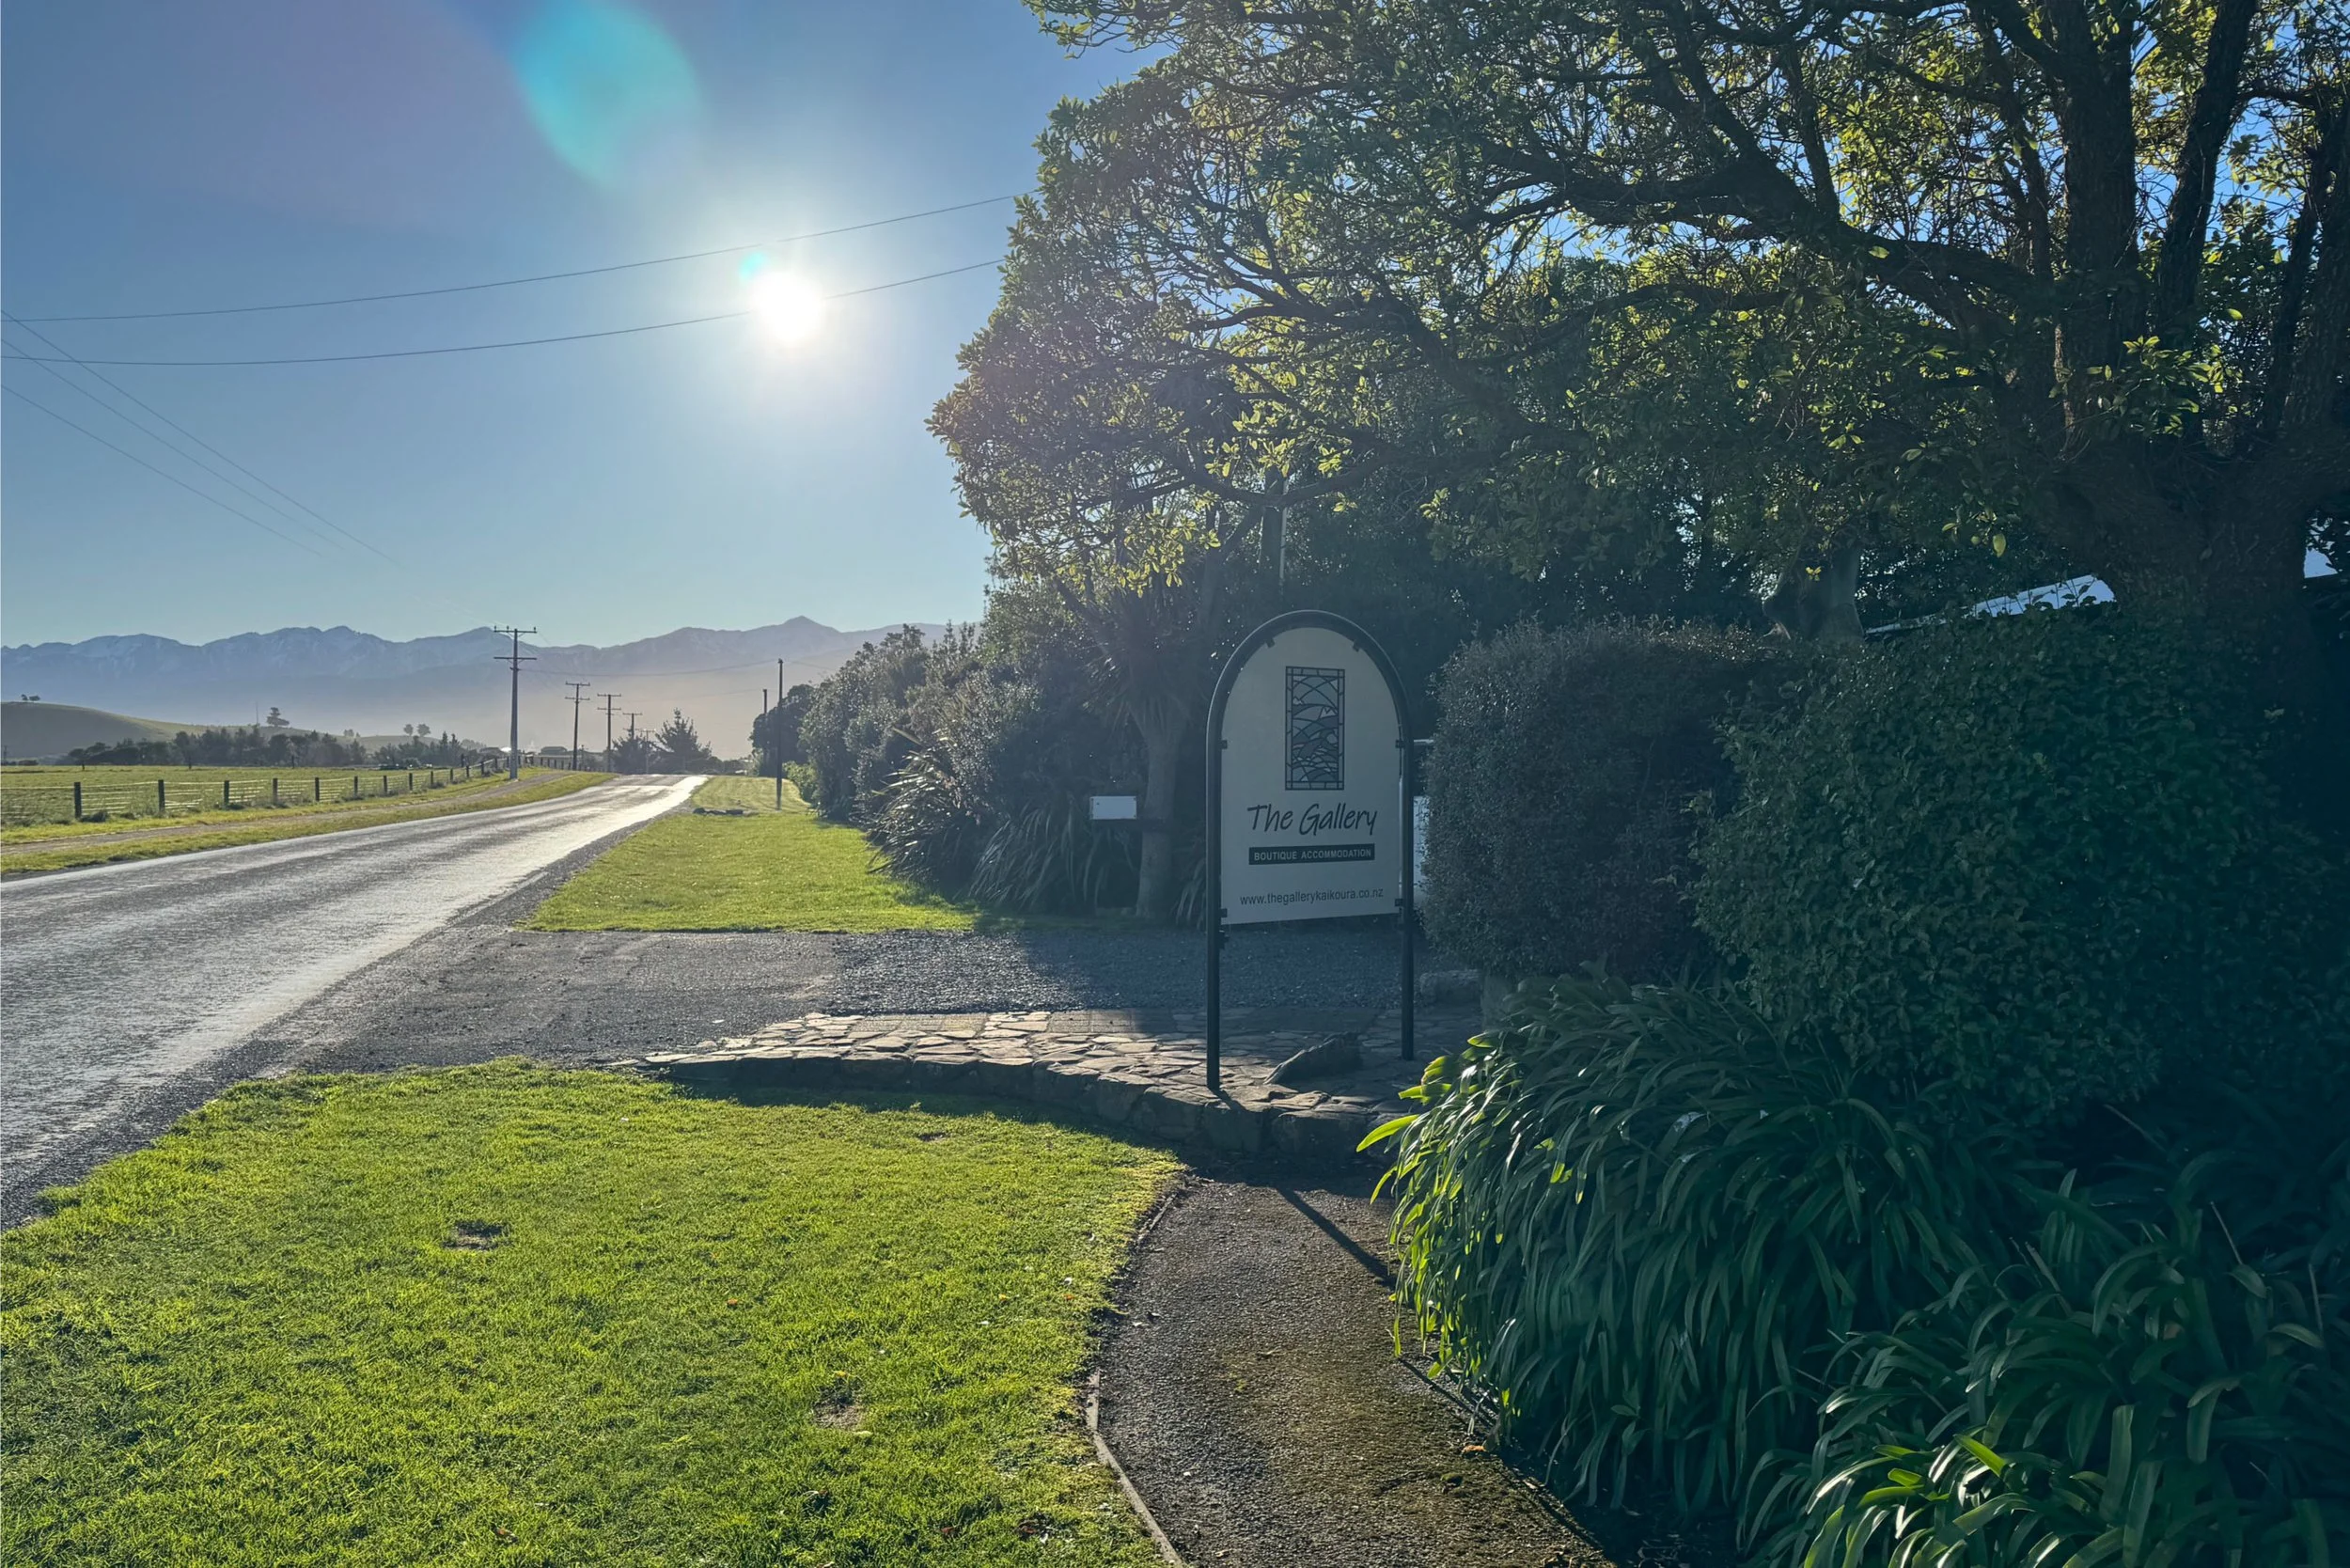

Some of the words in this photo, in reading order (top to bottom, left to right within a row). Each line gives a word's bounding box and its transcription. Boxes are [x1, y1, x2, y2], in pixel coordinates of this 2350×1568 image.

[1246, 803, 1293, 832] The
[1299, 802, 1378, 836] Gallery
[1253, 851, 1297, 861] BOUTIQUE
[1301, 848, 1371, 860] ACCOMMODATION
[1240, 887, 1385, 906] www.thegallerykaikoura.co.nz
